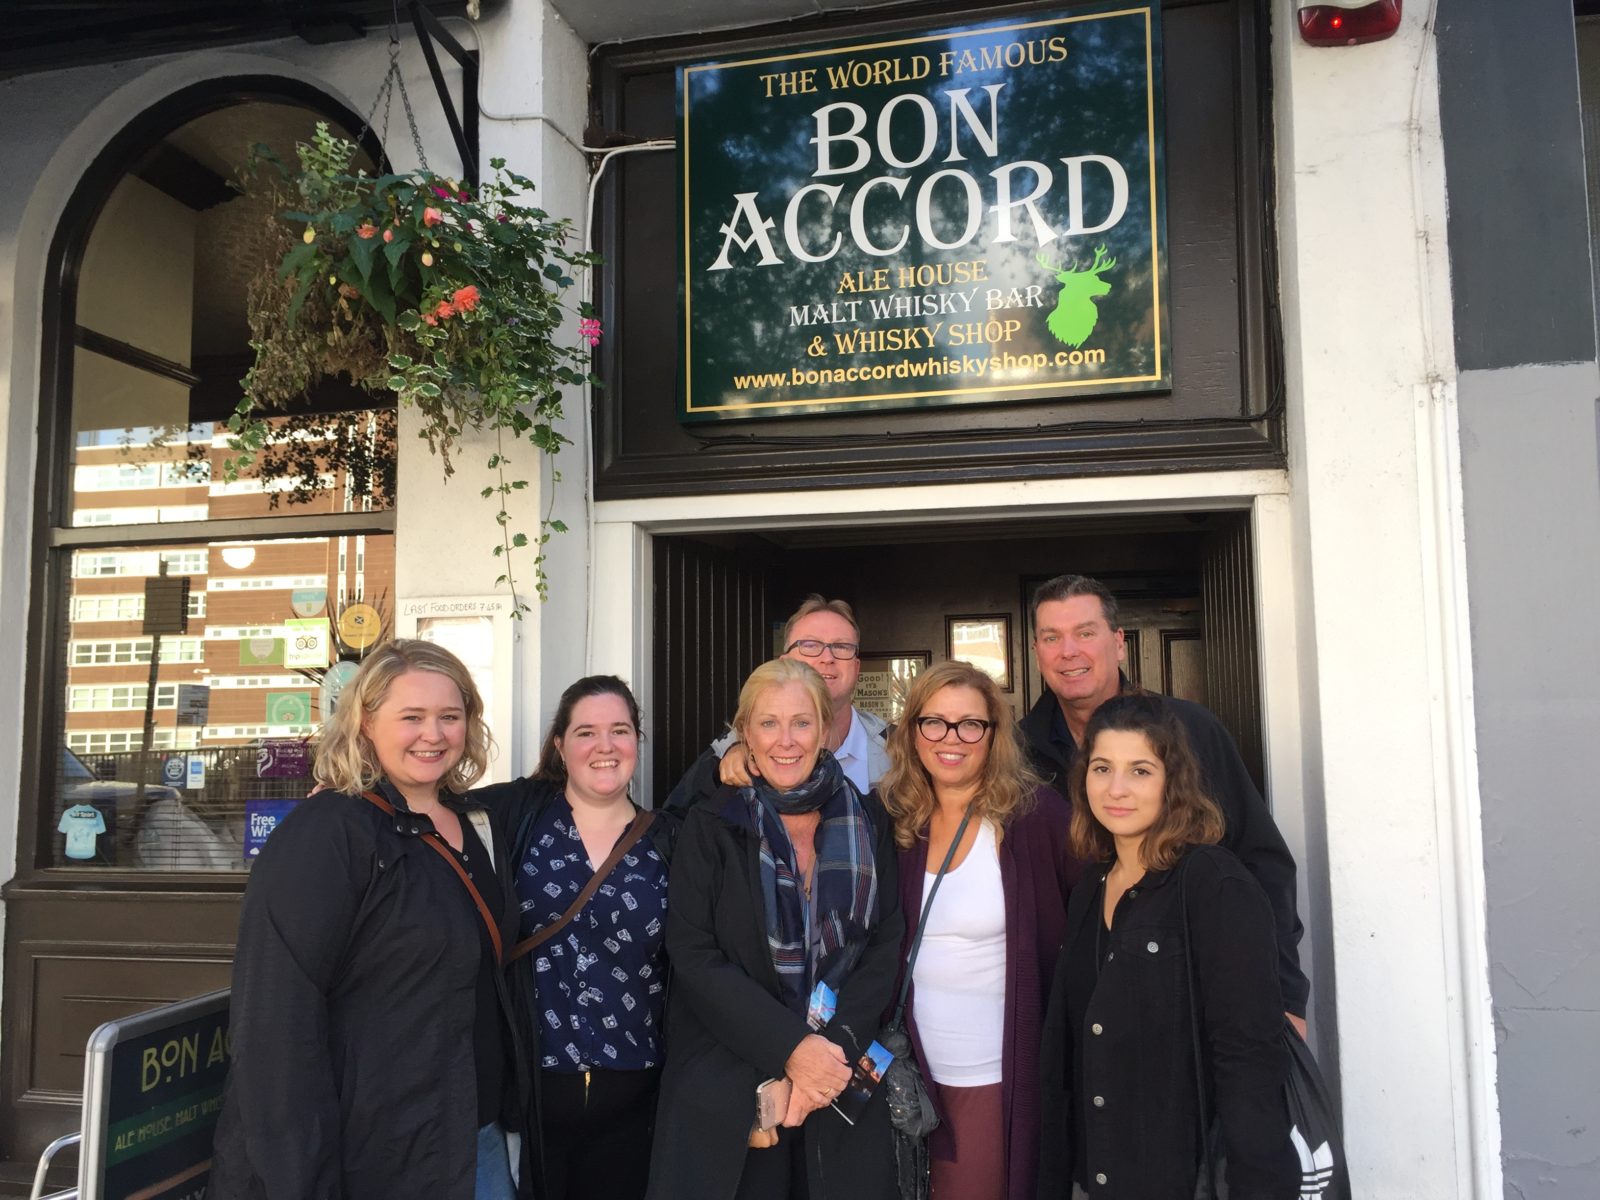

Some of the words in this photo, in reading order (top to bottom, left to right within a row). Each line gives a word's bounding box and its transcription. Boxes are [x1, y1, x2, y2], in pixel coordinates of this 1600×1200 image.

[760, 69, 817, 98] THE
[827, 55, 931, 90] WORLD
[939, 37, 1068, 77] FAMOUS
[809, 83, 1007, 178] BON
[707, 154, 1129, 271] ACCORD
[837, 268, 890, 295] ALE
[898, 260, 988, 288] HOUSE
[790, 300, 864, 328] MALT
[869, 287, 979, 320] WHISKY
[985, 285, 1043, 311] BAR
[807, 335, 828, 358] &
[835, 323, 944, 355] WHISKY
[948, 320, 1021, 347] SHOP
[734, 346, 1106, 390] www.bonaccordwhiskyshop.com
[404, 603, 428, 616] LAST
[450, 602, 477, 612] ORDERS
[857, 689, 888, 697] MASON'S
[251, 812, 276, 826] Free
[142, 1032, 199, 1092] BON
[115, 1130, 136, 1152] ALE
[138, 1115, 173, 1142] HOUSE
[175, 1104, 199, 1127] MALT
